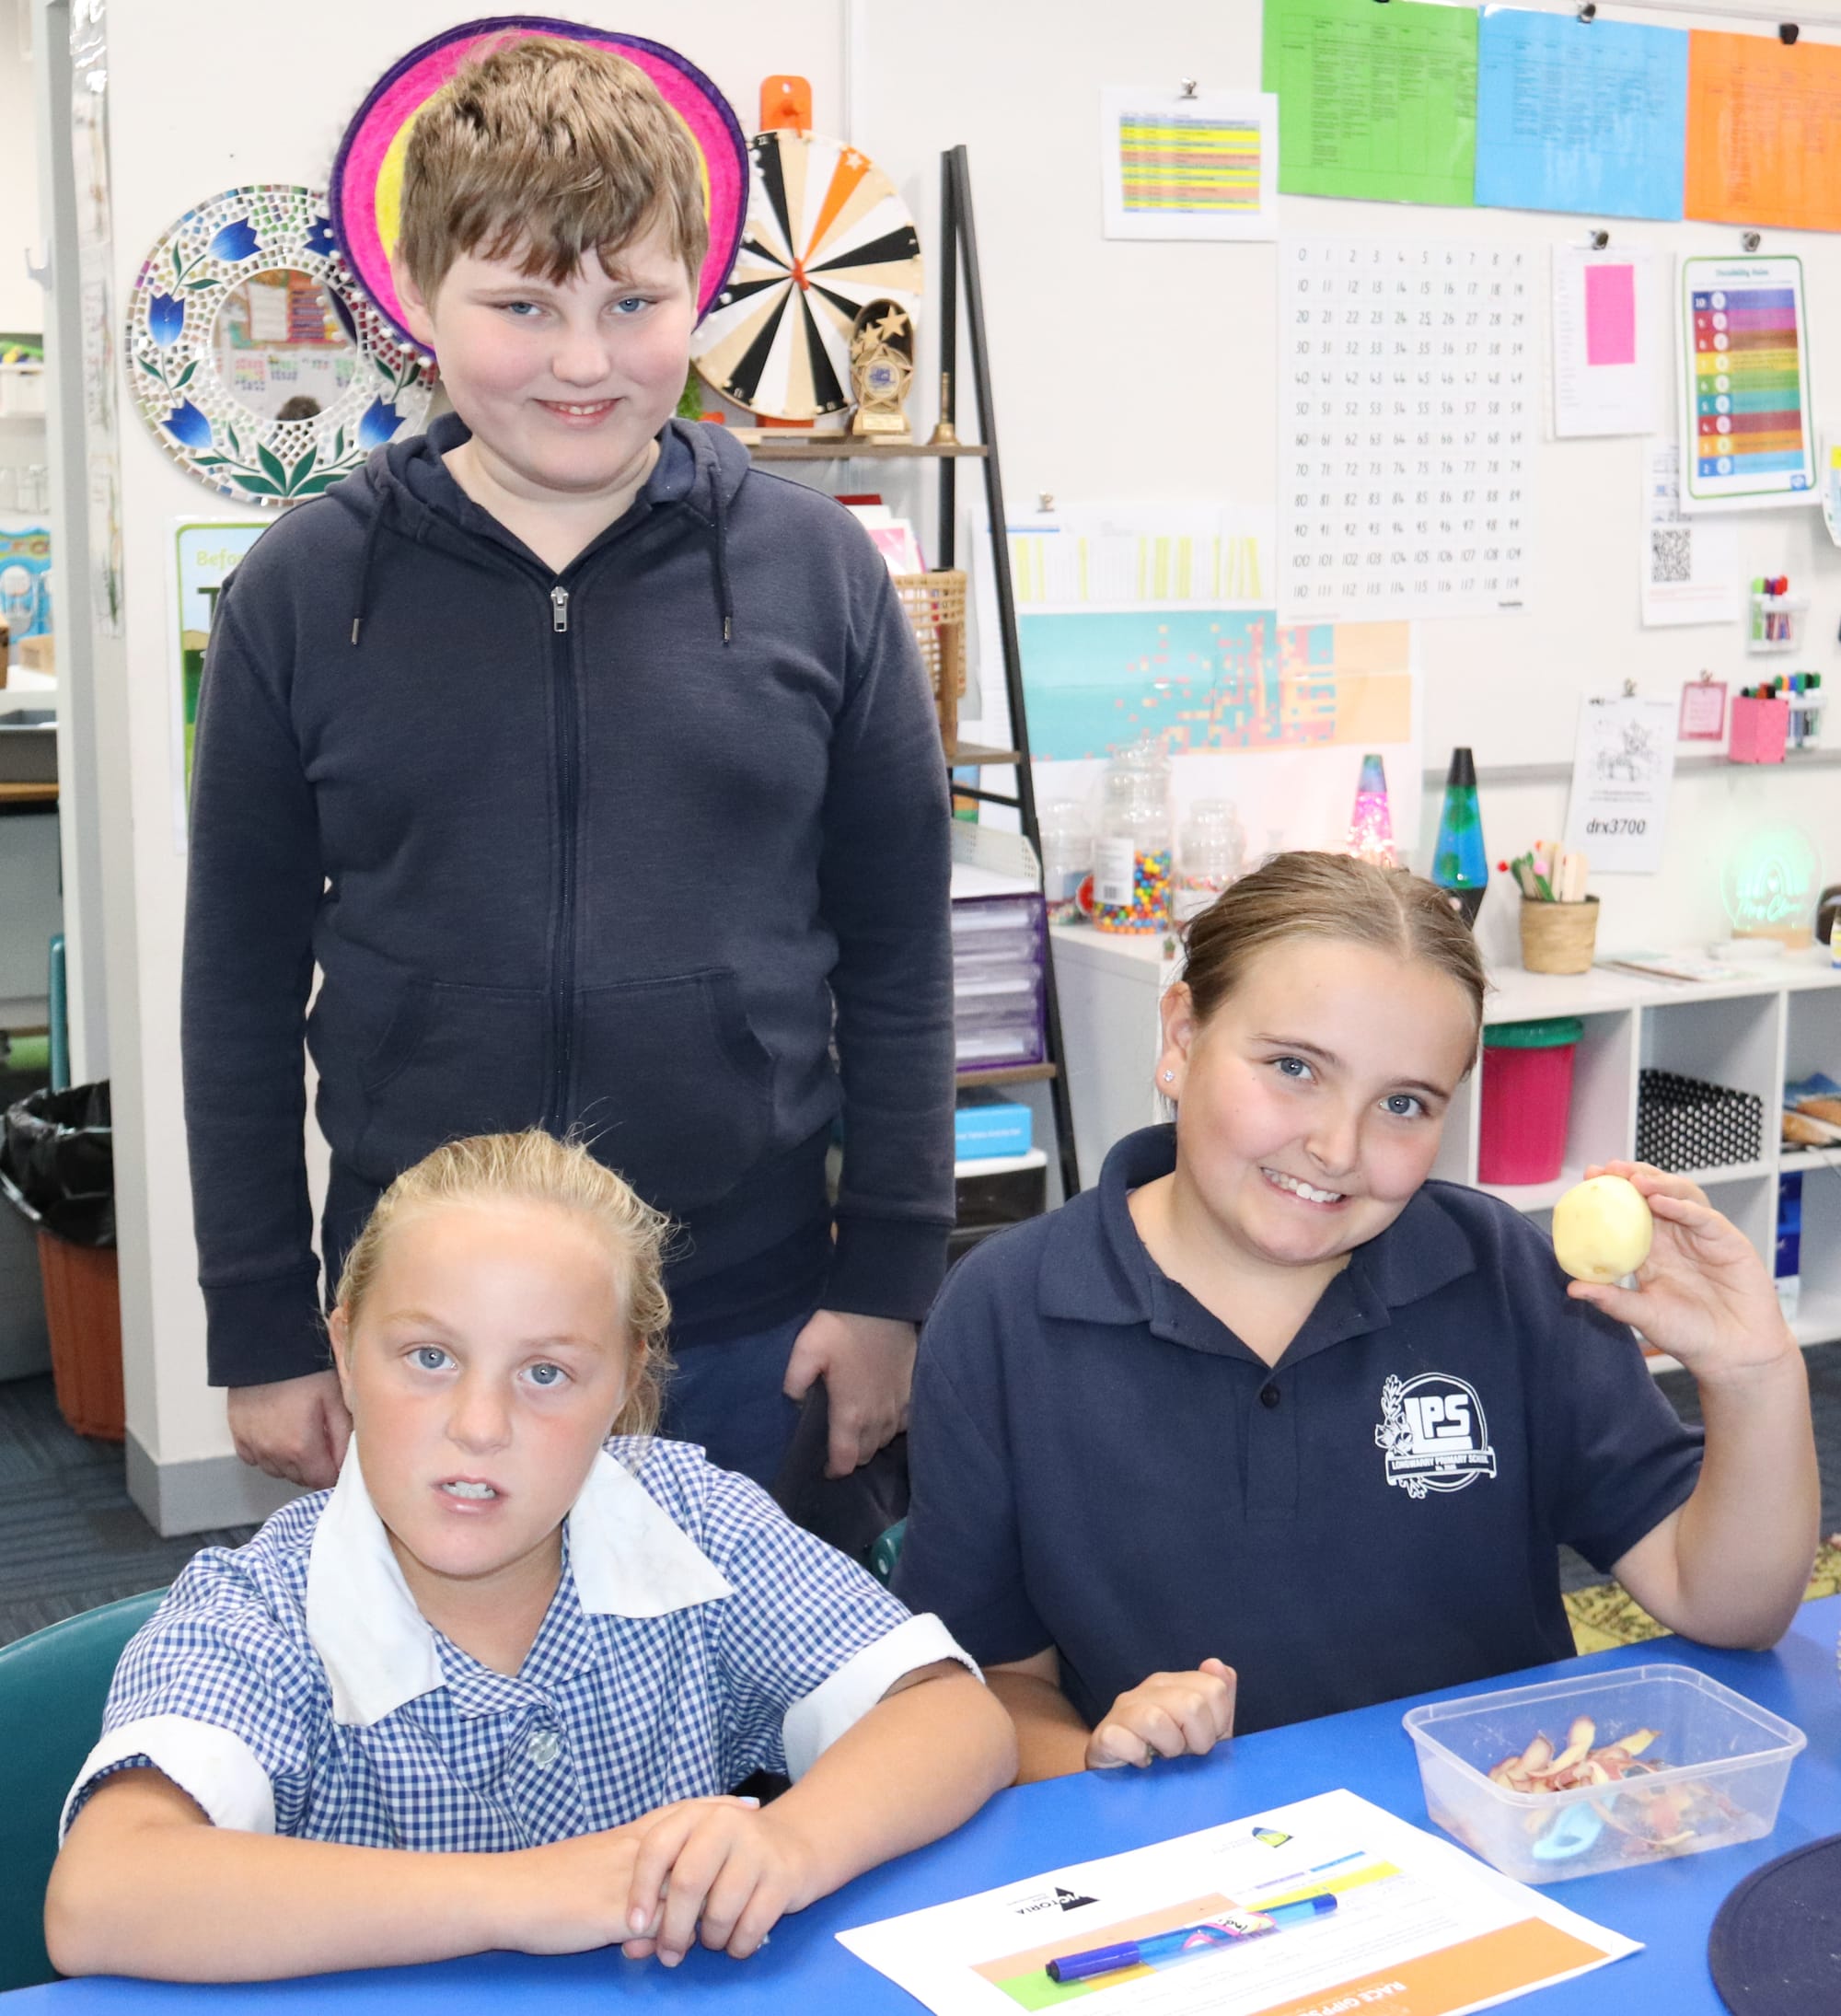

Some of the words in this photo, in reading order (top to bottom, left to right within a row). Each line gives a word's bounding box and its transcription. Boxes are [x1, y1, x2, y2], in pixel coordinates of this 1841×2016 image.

[1298, 279, 1309, 293] 10
[1323, 280, 1332, 293] 11
[1348, 280, 1360, 294] 12
[1372, 281, 1383, 294] 13
[1396, 281, 1407, 294] 14
[1420, 281, 1430, 295] 15
[1444, 283, 1454, 295] 16
[1467, 282, 1478, 295] 17
[1491, 284, 1501, 296] 18
[1514, 284, 1523, 295] 19
[1696, 297, 1707, 308] 10
[1296, 309, 1309, 323] 20
[1322, 309, 1331, 324] 21
[1346, 310, 1359, 324] 22
[1371, 311, 1383, 324] 23
[1395, 311, 1407, 324] 24
[1419, 311, 1431, 326] 25
[1442, 312, 1454, 325] 26
[1465, 312, 1478, 326] 27
[1489, 313, 1501, 326] 28
[1511, 313, 1524, 326] 29
[1296, 341, 1310, 353] 30
[1321, 341, 1331, 353] 31
[1346, 342, 1359, 355] 32
[1370, 342, 1383, 355] 33
[1394, 342, 1407, 353] 34
[1418, 342, 1430, 355] 35
[1442, 342, 1454, 354] 36
[1465, 342, 1477, 355] 37
[1488, 342, 1500, 355] 38
[1511, 342, 1523, 355] 39
[1295, 371, 1310, 385] 40
[1321, 372, 1332, 385] 41
[1346, 372, 1359, 385] 42
[1370, 372, 1383, 385] 43
[1394, 372, 1407, 384] 44
[1418, 372, 1430, 385] 45
[1442, 373, 1454, 385] 46
[1465, 371, 1476, 384] 47
[1488, 372, 1500, 385] 48
[1511, 372, 1523, 383] 49
[1296, 401, 1310, 415] 50
[1322, 401, 1331, 415] 51
[1345, 402, 1358, 416] 52
[1370, 401, 1383, 415] 53
[1394, 401, 1407, 415] 54
[1418, 401, 1430, 415] 55
[1442, 401, 1453, 415] 56
[1465, 401, 1476, 414] 57
[1488, 401, 1499, 414] 58
[1511, 401, 1523, 414] 59
[1296, 434, 1309, 446] 60
[1321, 434, 1330, 446] 61
[1345, 433, 1358, 446] 62
[1370, 433, 1382, 446] 63
[1393, 434, 1407, 446] 64
[1418, 432, 1429, 446] 65
[1441, 434, 1453, 445] 66
[1465, 431, 1476, 445] 67
[1488, 432, 1499, 445] 68
[1511, 432, 1522, 444] 69
[1296, 464, 1309, 477] 70
[1321, 462, 1331, 476] 71
[1346, 462, 1359, 476] 72
[1370, 462, 1382, 475] 73
[1394, 461, 1406, 474] 74
[1418, 461, 1429, 474] 75
[1442, 461, 1453, 474] 76
[1464, 460, 1476, 473] 77
[1488, 460, 1499, 473] 78
[1511, 459, 1521, 471] 79
[1295, 493, 1308, 507] 80
[1320, 493, 1329, 506] 81
[1344, 493, 1357, 506] 82
[1368, 492, 1380, 505] 83
[1392, 492, 1405, 505] 84
[1416, 491, 1428, 504] 85
[1440, 491, 1452, 504] 86
[1463, 490, 1475, 504] 87
[1487, 490, 1499, 503] 88
[1510, 490, 1521, 502] 89
[1292, 554, 1310, 567] 100
[1318, 553, 1333, 567] 101
[1342, 552, 1359, 566] 102
[1367, 552, 1382, 565] 103
[1391, 551, 1407, 564] 104
[1414, 550, 1429, 563] 105
[1438, 550, 1453, 562] 106
[1461, 549, 1476, 562] 107
[1484, 548, 1499, 561] 108
[1506, 548, 1522, 560] 109
[1586, 817, 1647, 834] drx3700
[1360, 1981, 1407, 2002] RACE
